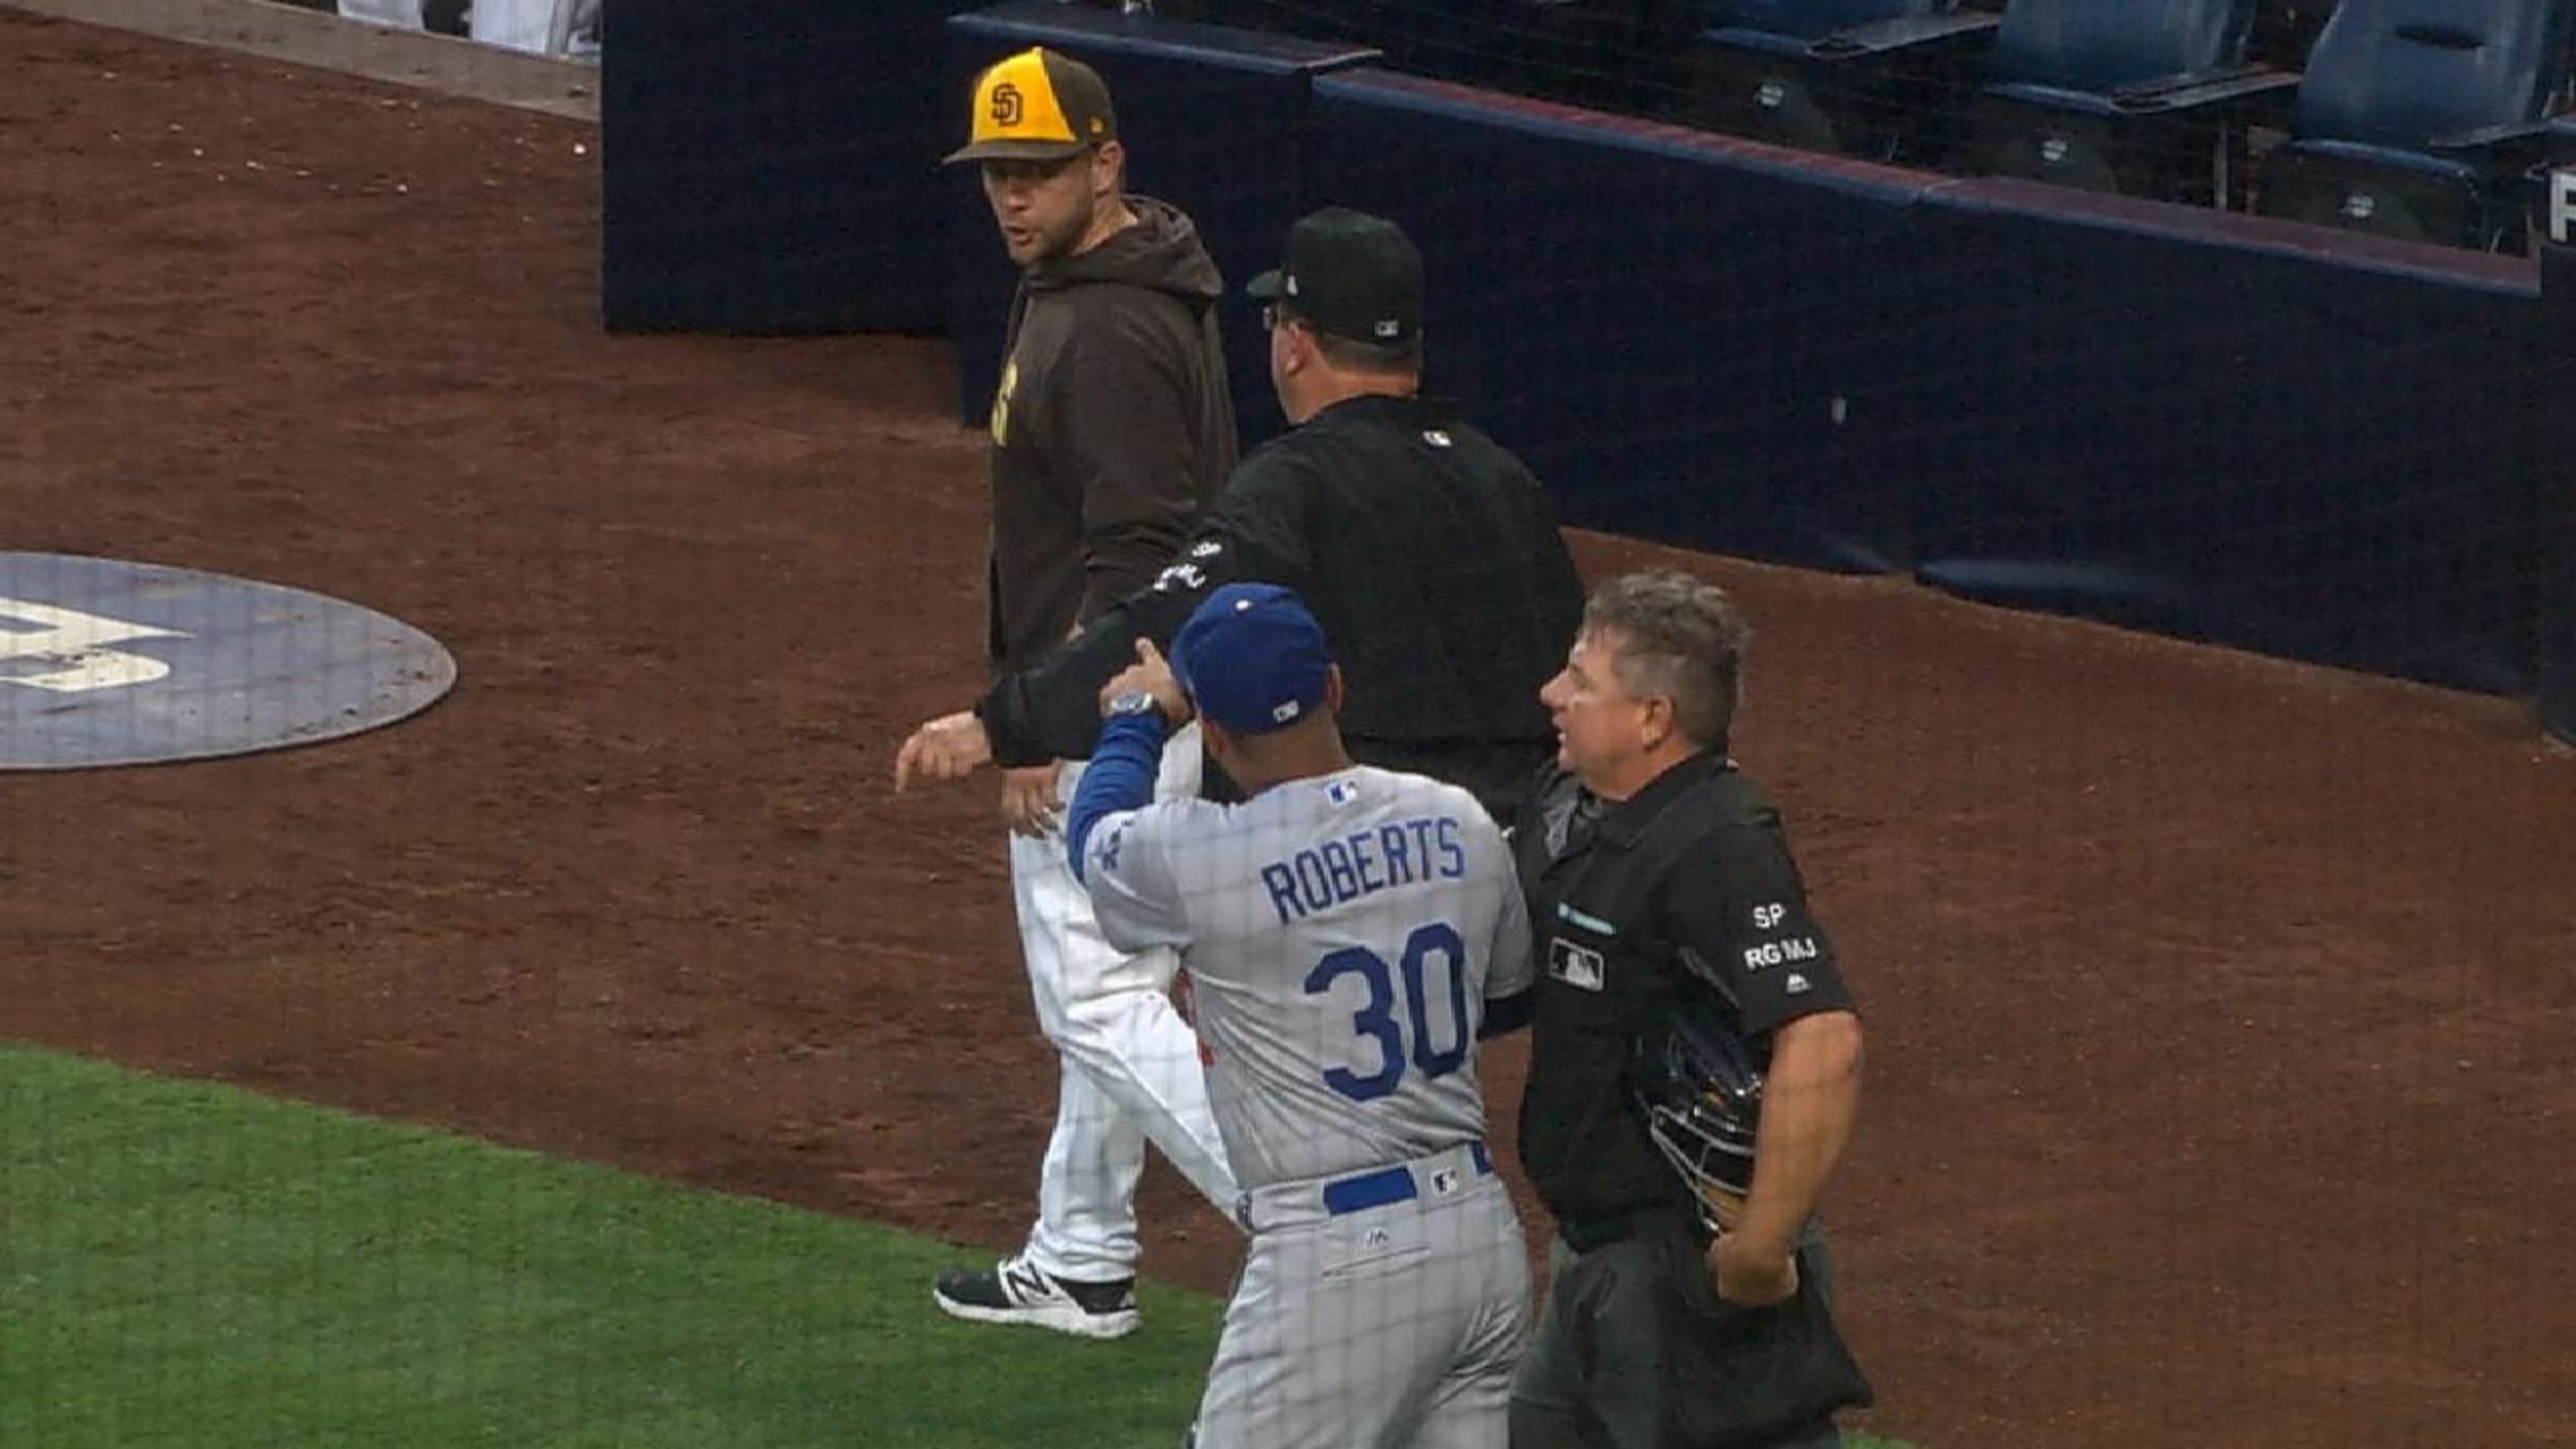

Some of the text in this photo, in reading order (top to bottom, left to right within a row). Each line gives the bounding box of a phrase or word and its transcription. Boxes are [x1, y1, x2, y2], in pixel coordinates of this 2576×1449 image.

[991, 81, 1023, 127] SD
[1262, 818, 1465, 924] ROBERTS
[1753, 902, 1786, 929] SP
[1304, 922, 1467, 1101] 30
